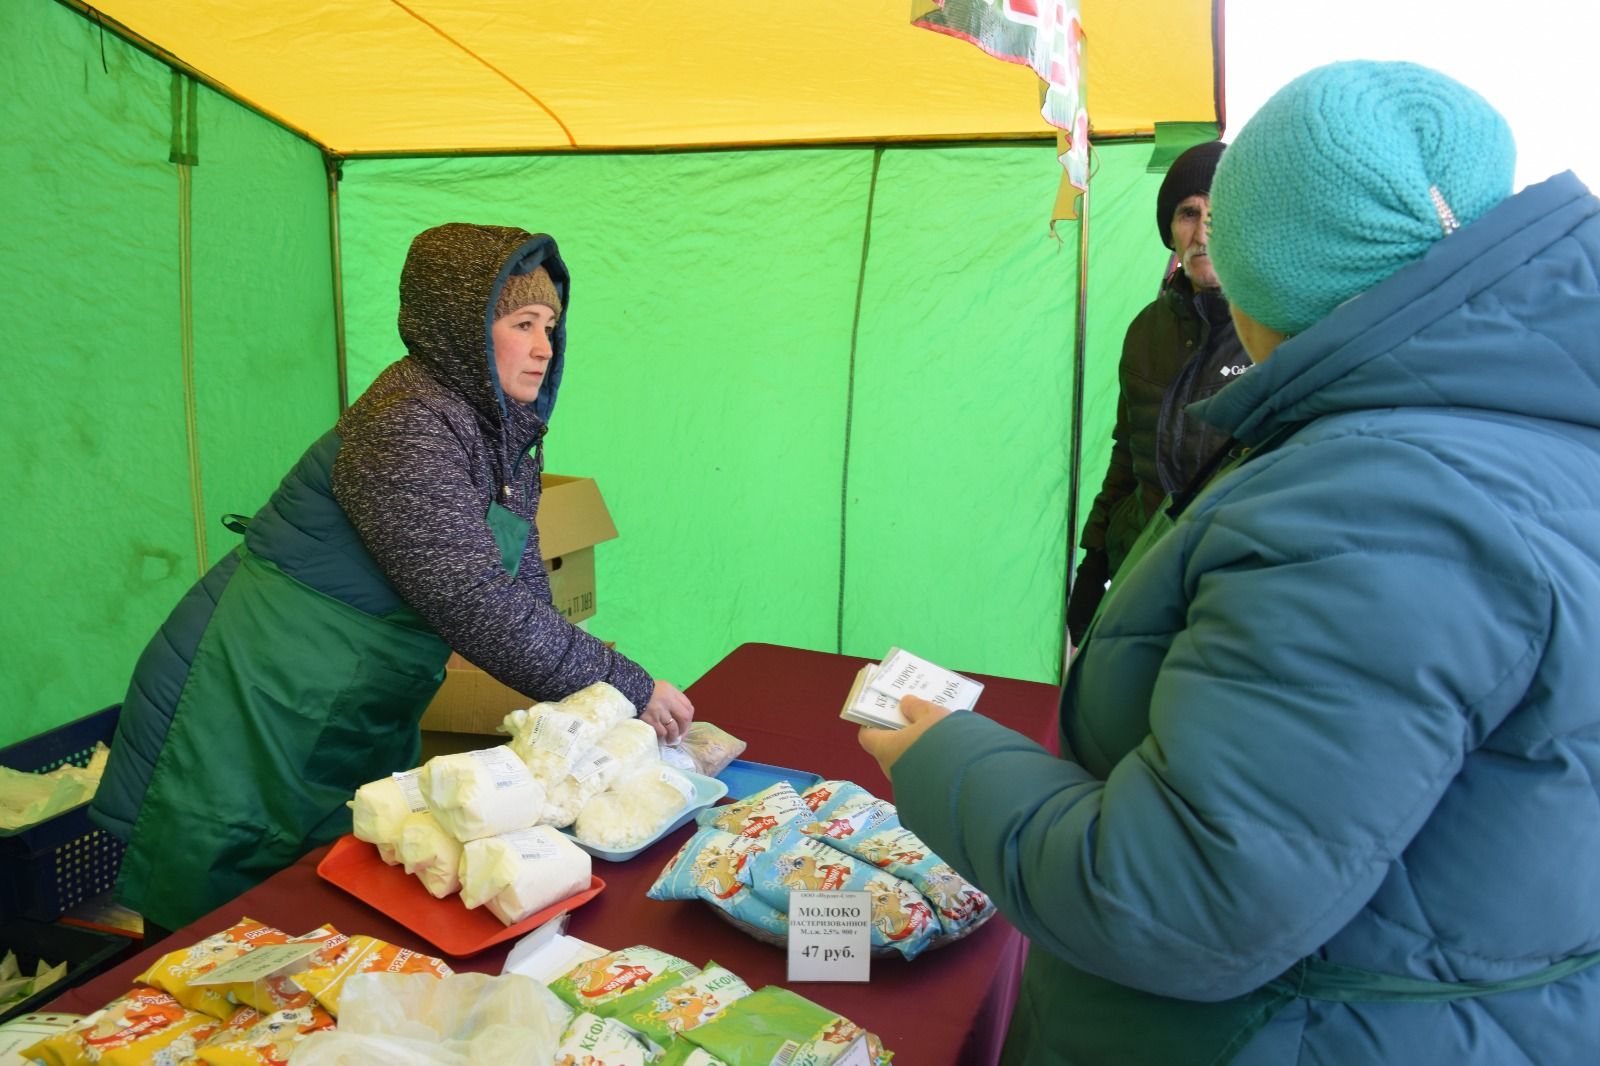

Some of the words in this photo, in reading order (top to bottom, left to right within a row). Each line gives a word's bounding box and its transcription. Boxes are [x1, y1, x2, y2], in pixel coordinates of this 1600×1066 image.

[892, 663, 918, 690] ТВОРОГ
[944, 679, 961, 701] руб.
[799, 907, 861, 918] МОЛОКО
[386, 947, 412, 973] РЯЖЕ
[801, 945, 819, 958] 47
[824, 945, 855, 962] руб.
